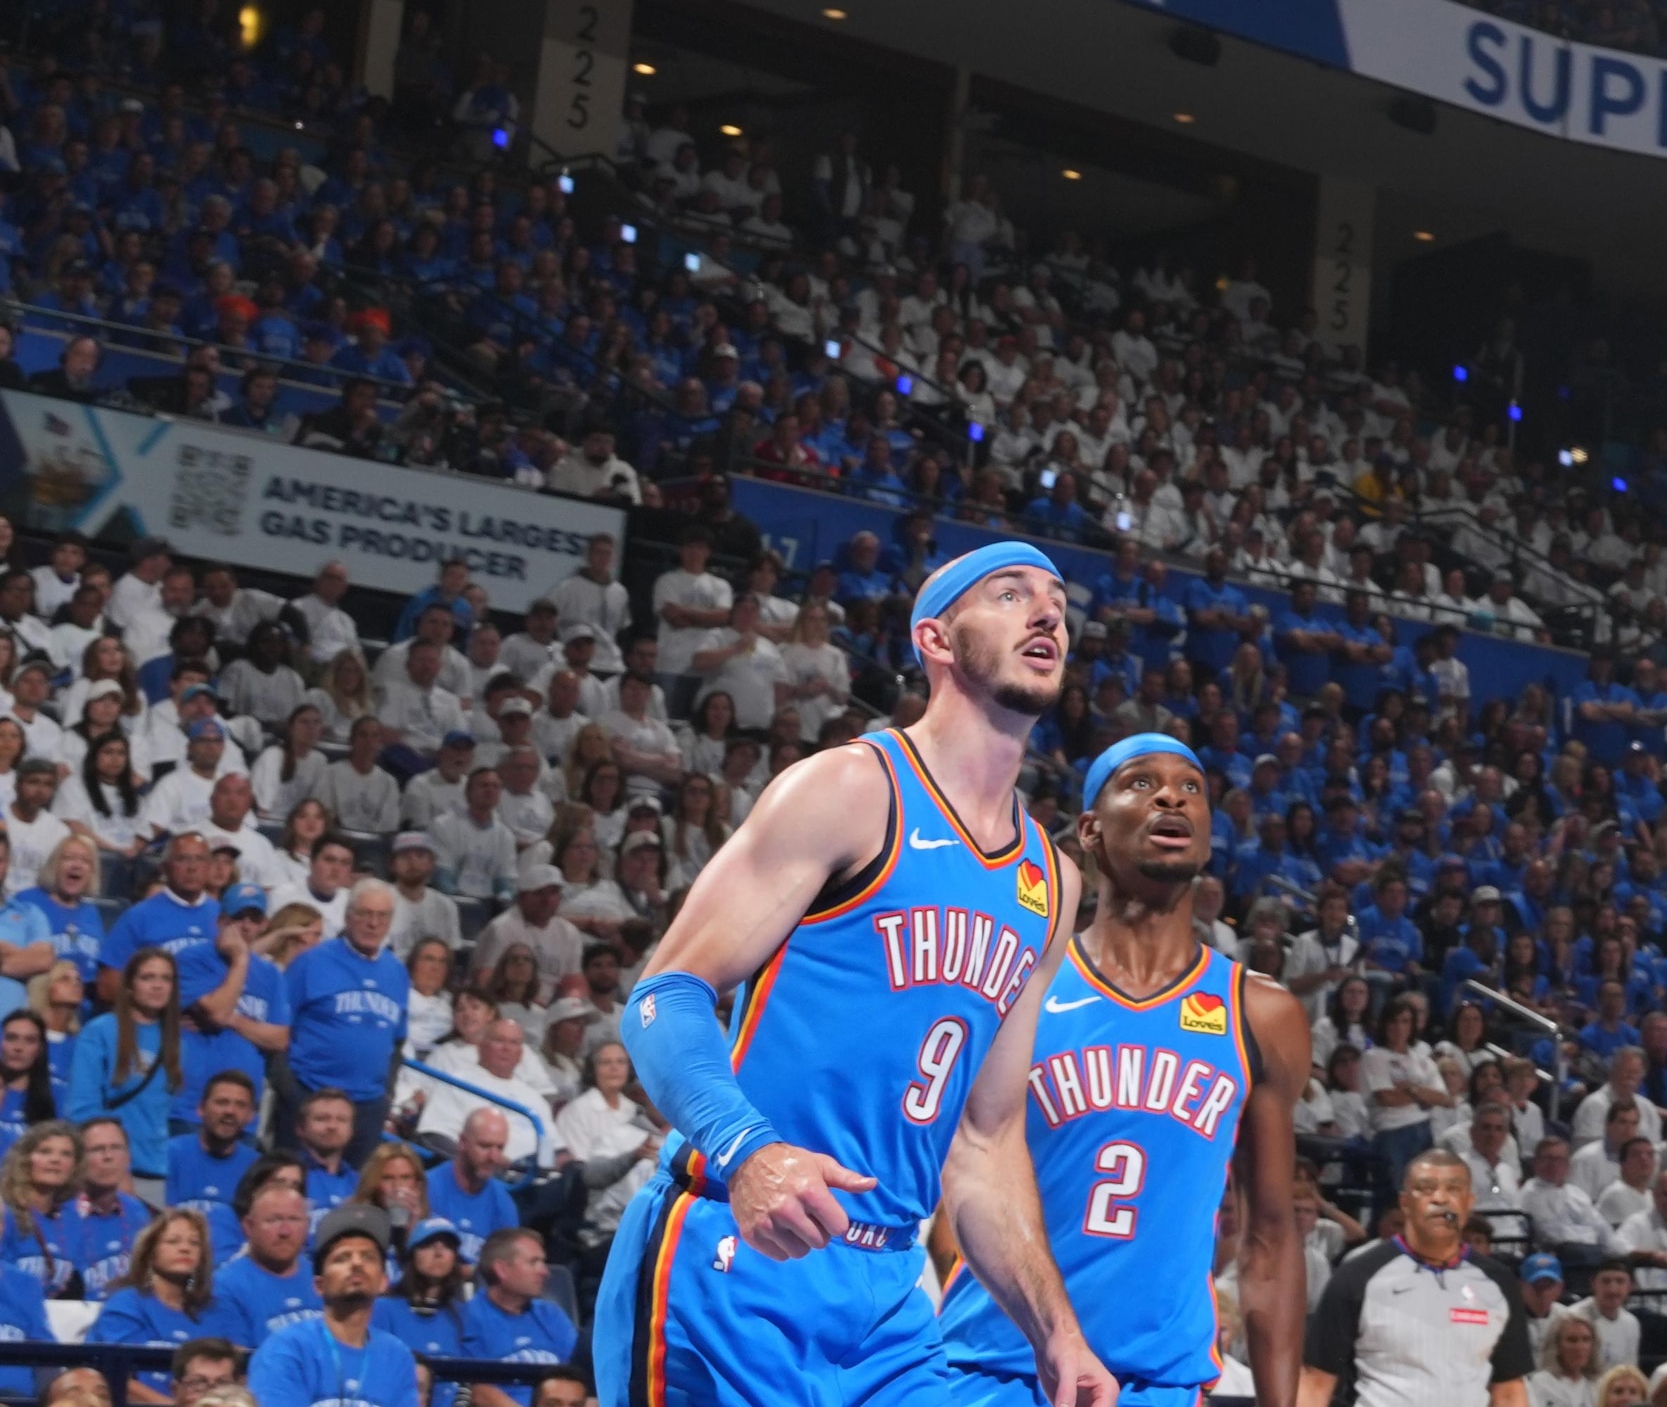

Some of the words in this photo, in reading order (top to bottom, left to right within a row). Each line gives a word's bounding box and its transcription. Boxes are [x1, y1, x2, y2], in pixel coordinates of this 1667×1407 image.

[566, 5, 599, 130] 225
[1331, 222, 1354, 331] 225
[260, 509, 332, 545] GAS
[336, 523, 527, 582] PRODUCER
[262, 475, 451, 533] AMERICA'S
[873, 905, 1038, 1020] THUNDE
[902, 1015, 969, 1125] 9
[1028, 1043, 1239, 1142] THUNDER
[1082, 1138, 1148, 1241] 2
